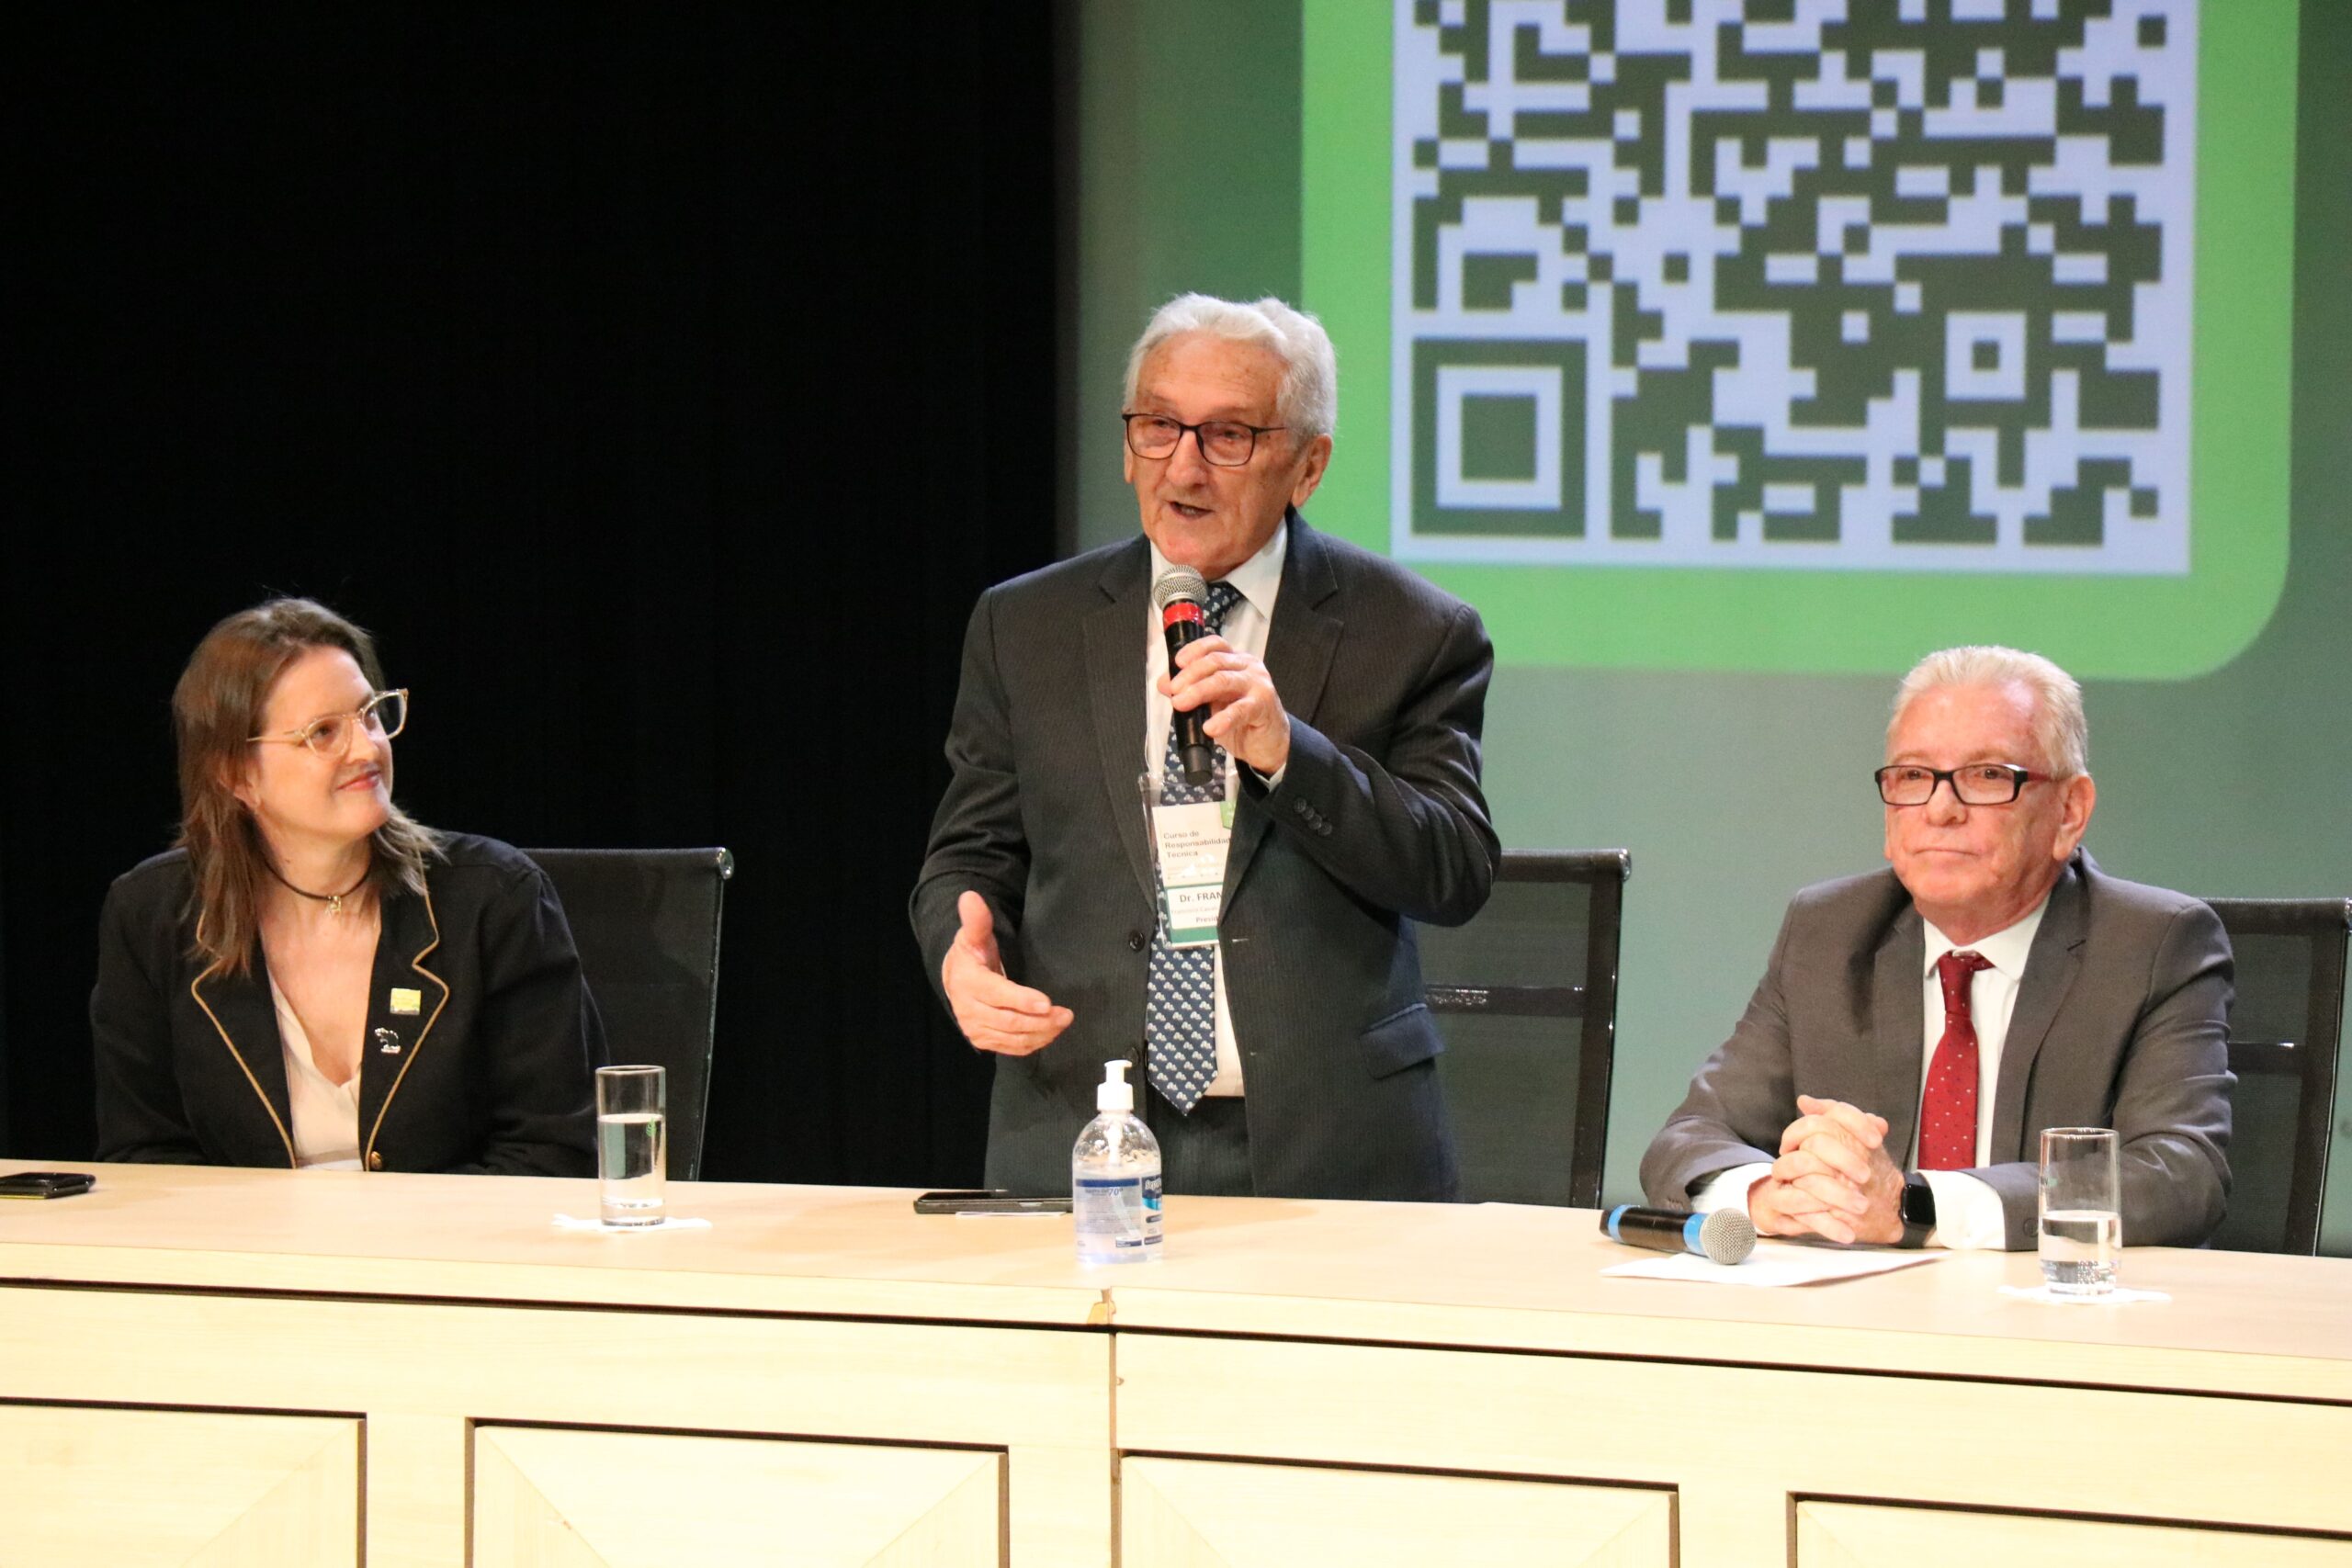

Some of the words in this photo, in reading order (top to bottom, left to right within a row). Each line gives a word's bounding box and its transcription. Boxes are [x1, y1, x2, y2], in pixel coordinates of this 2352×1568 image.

[1163, 831, 1188, 840] Curso
[1189, 829, 1200, 838] de
[1179, 894, 1194, 903] Dr.
